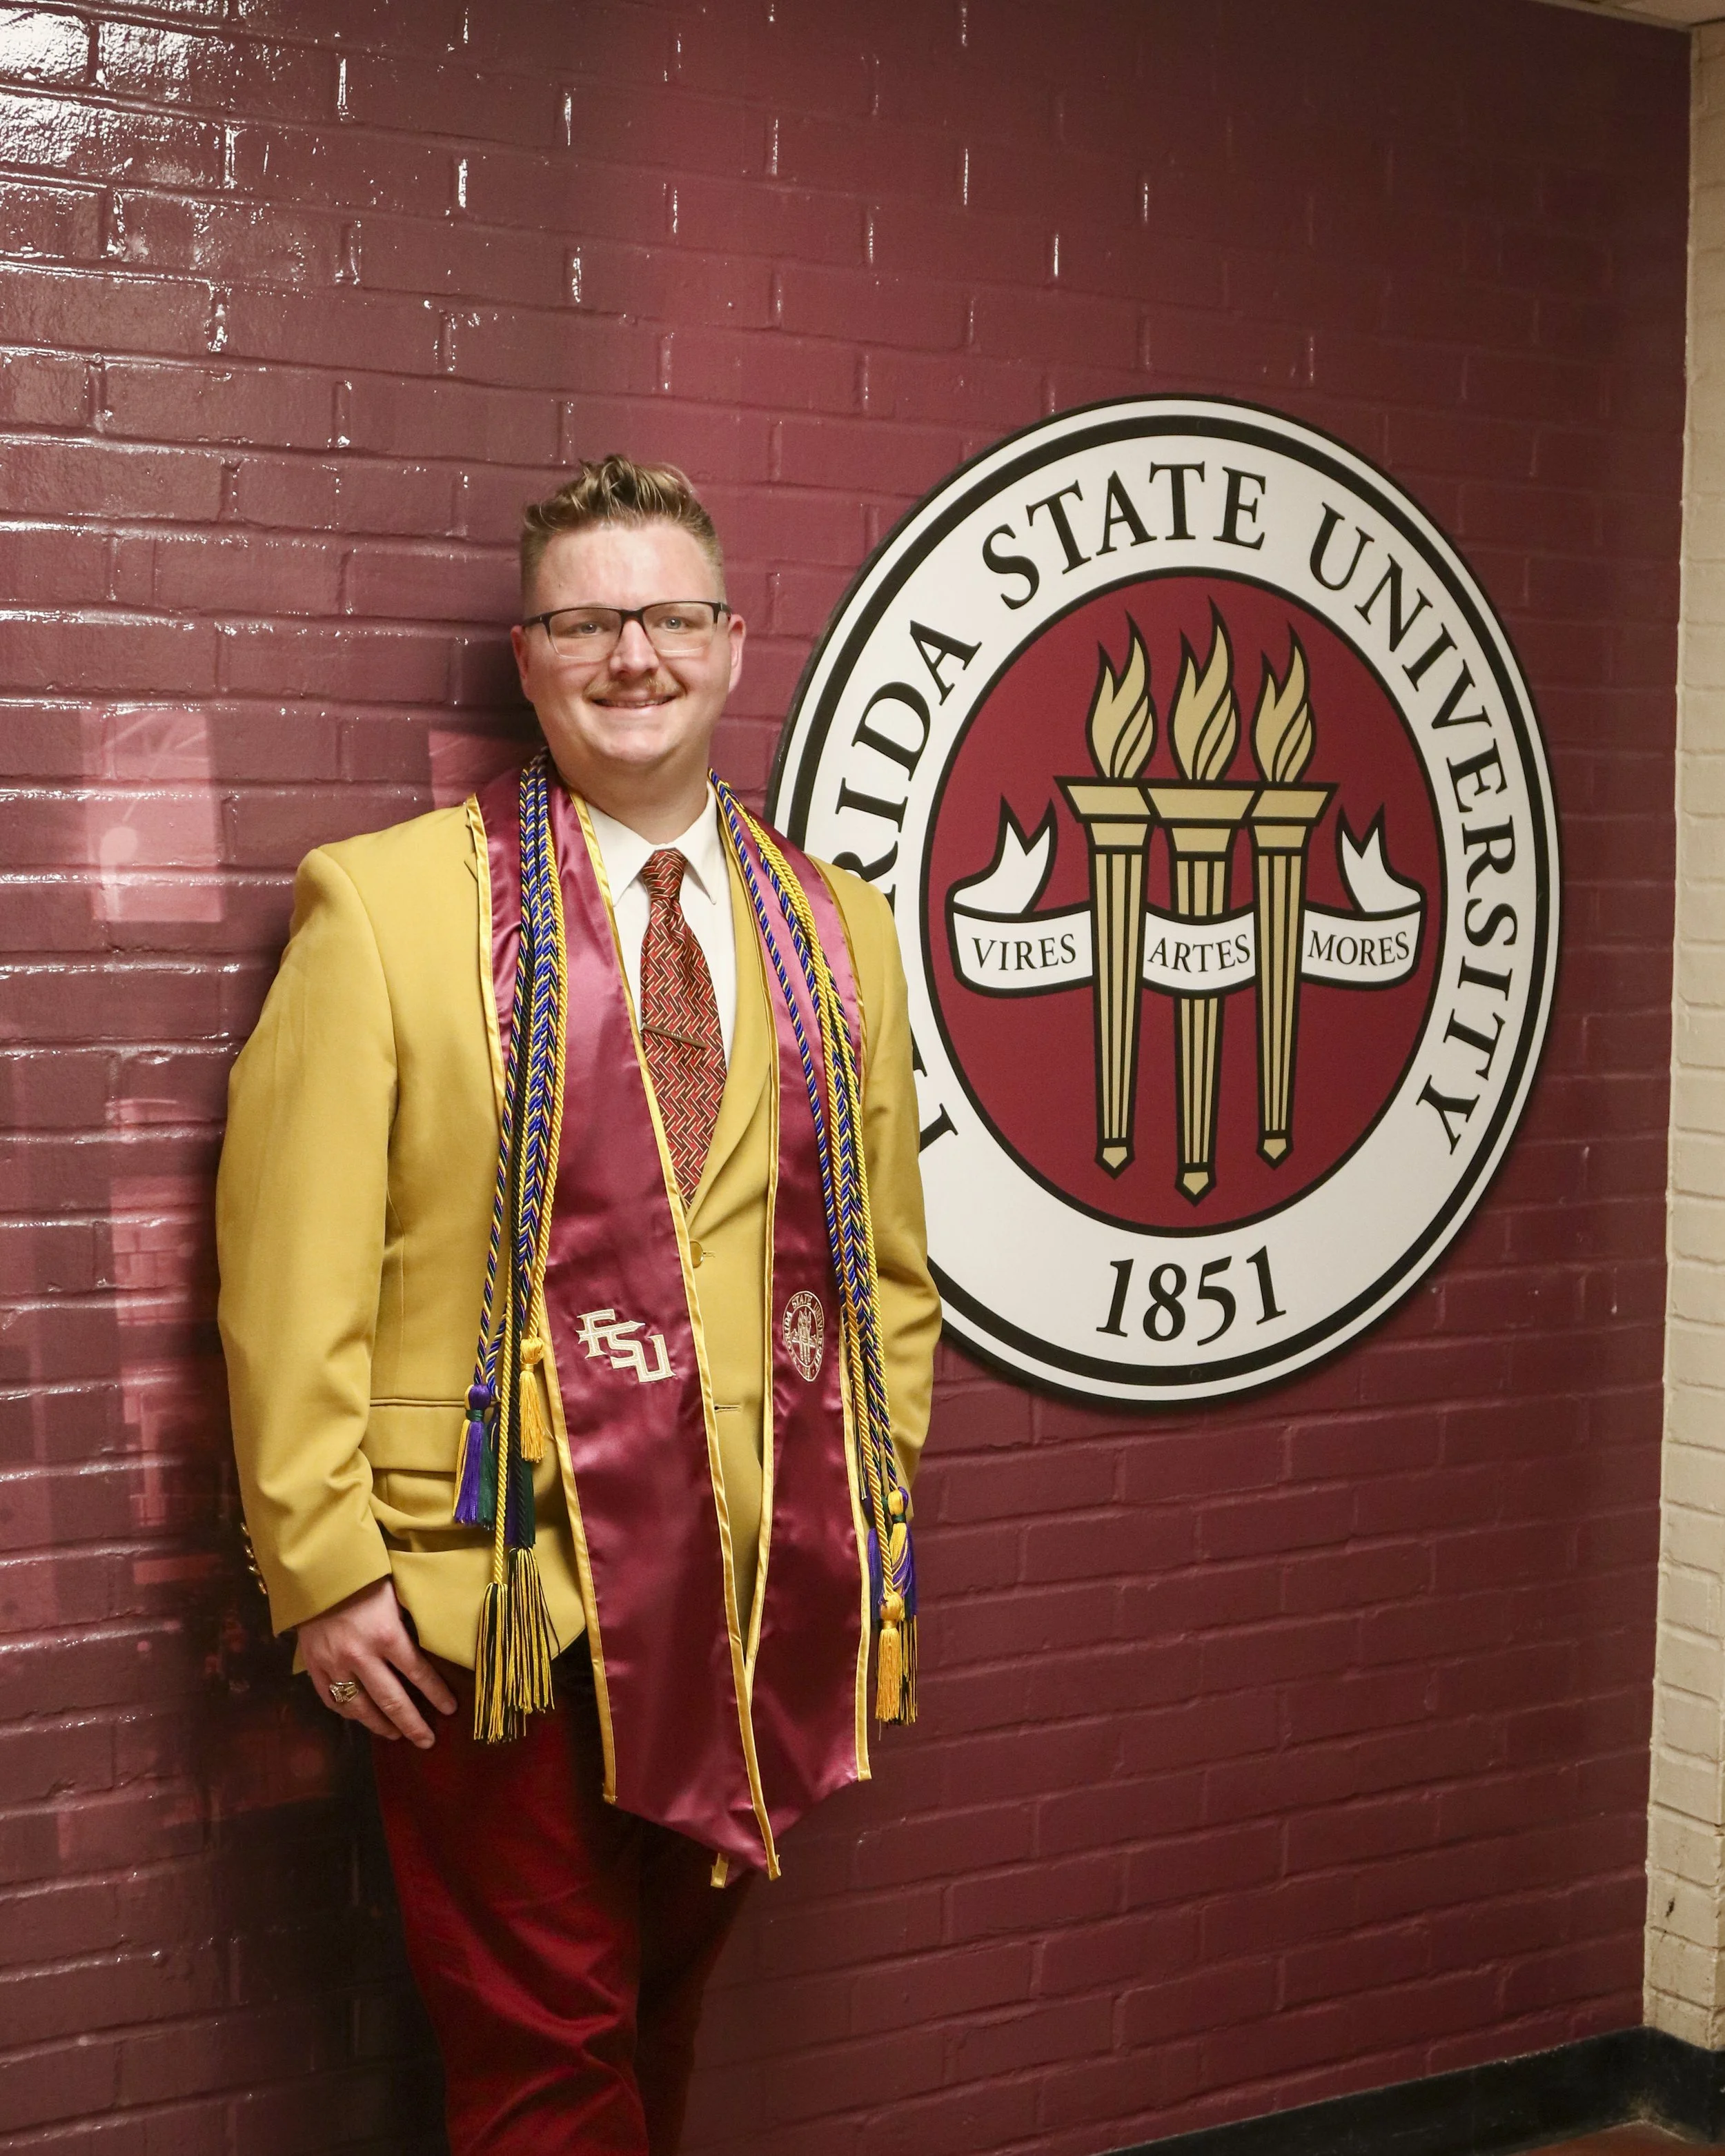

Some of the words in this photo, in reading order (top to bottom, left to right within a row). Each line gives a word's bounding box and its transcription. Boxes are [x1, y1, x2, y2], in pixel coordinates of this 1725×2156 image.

[983, 462, 1265, 609] STATE
[1310, 502, 1517, 1155] UNIVERSITY
[972, 933, 1076, 971] VIRES
[1148, 933, 1250, 973] ARTES
[1308, 930, 1410, 967] MORES
[791, 1293, 813, 1308] STATE
[1096, 1246, 1286, 1346] 1851
[575, 1309, 676, 1383] FSU
